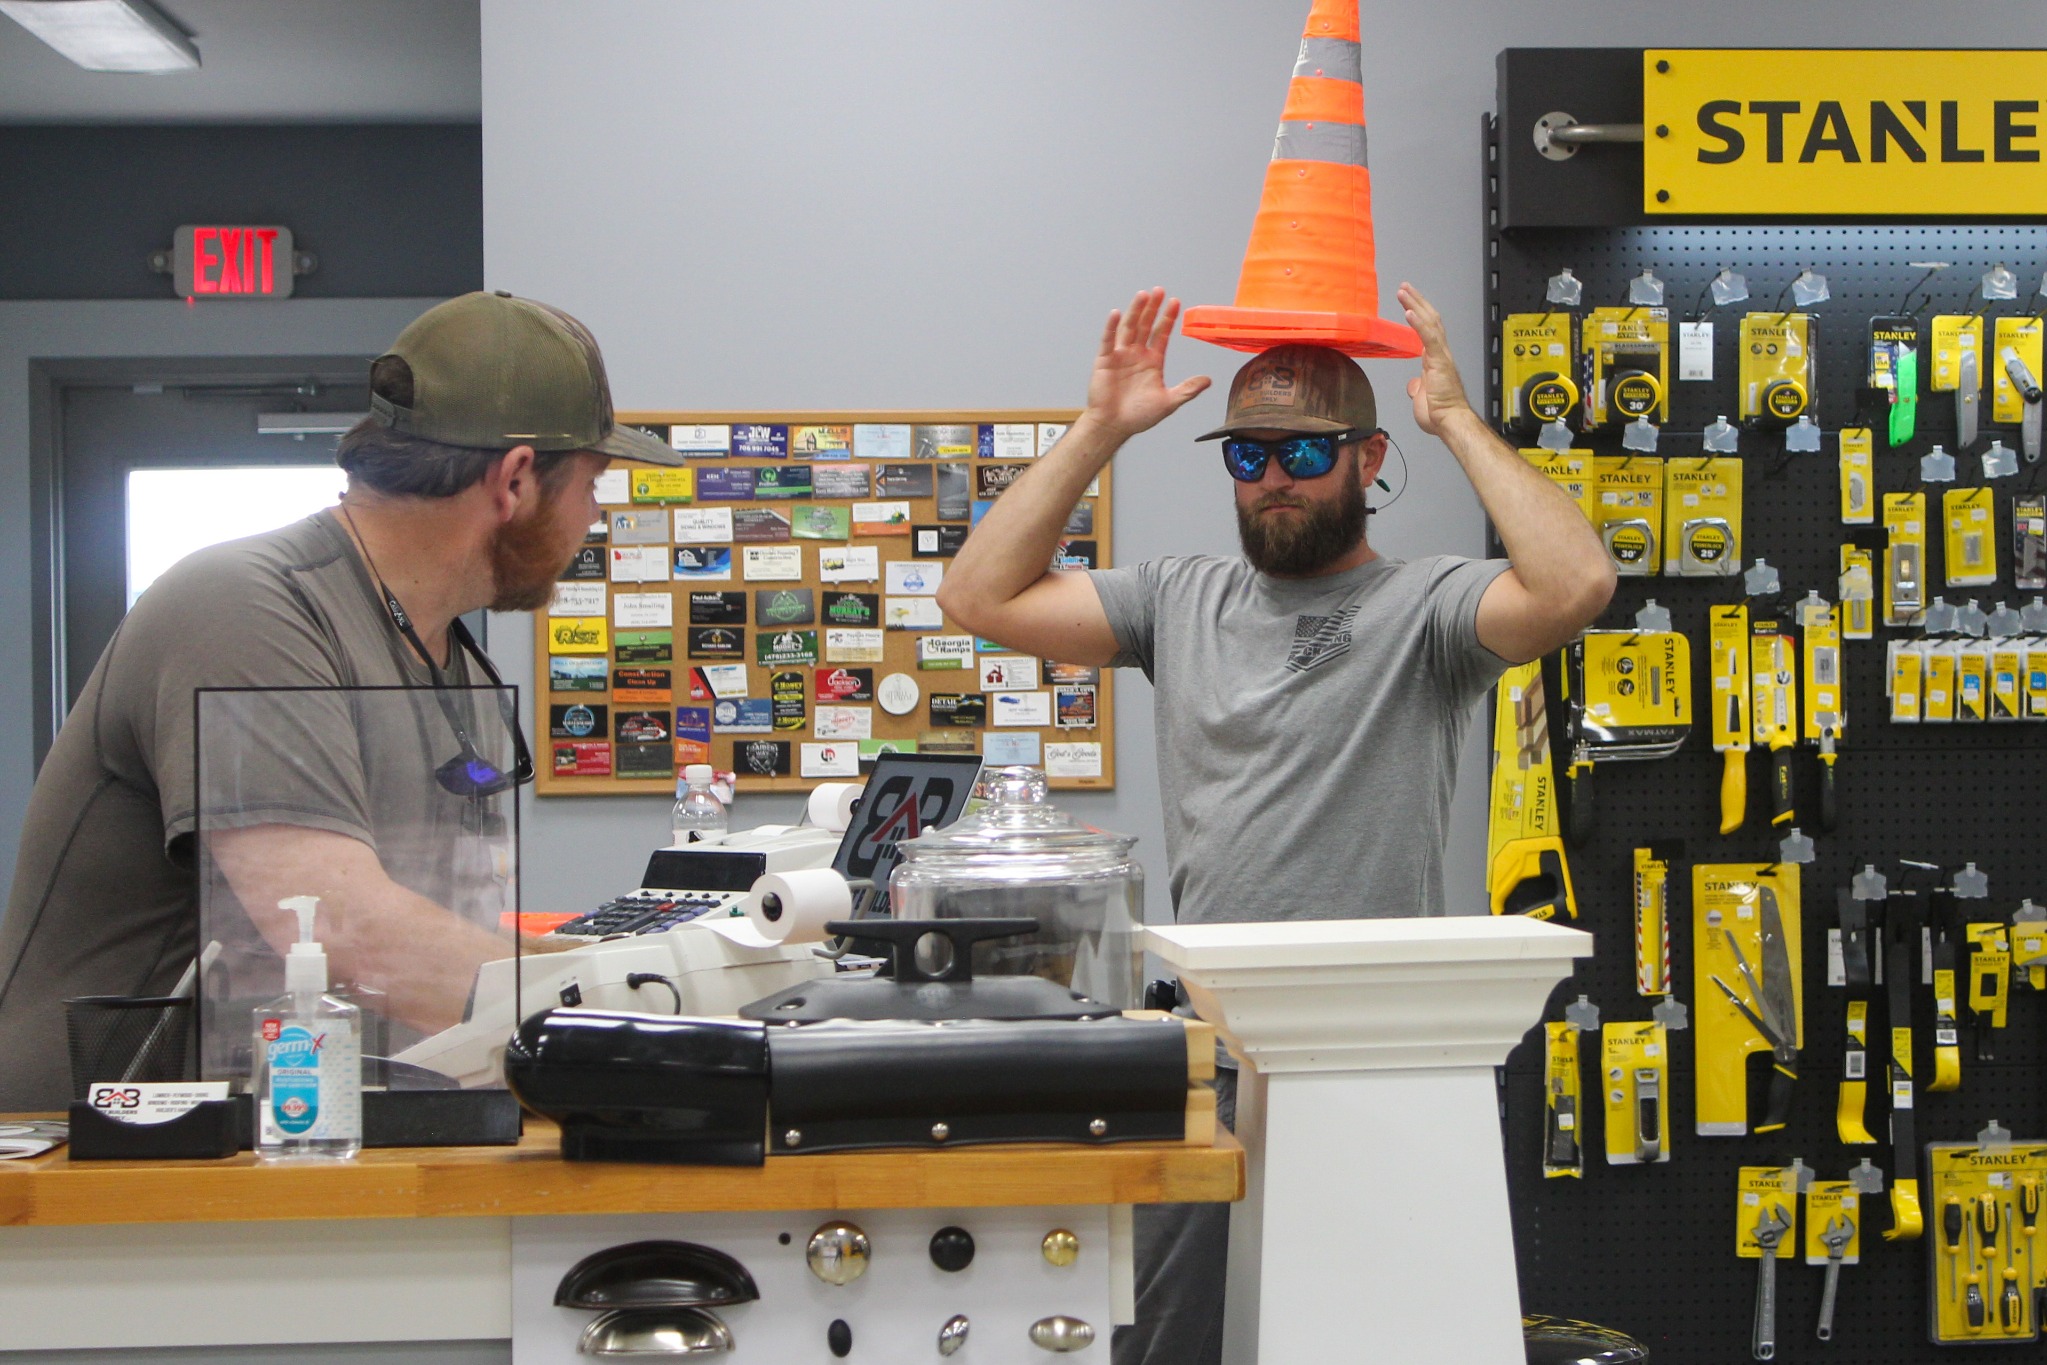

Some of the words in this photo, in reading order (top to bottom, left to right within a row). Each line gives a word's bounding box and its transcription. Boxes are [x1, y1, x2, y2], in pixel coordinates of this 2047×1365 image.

[1696, 99, 2046, 164] STANLE
[194, 227, 279, 294] EXIT
[1513, 329, 1557, 337] STANLEY
[1751, 328, 1794, 336] STANLEY
[1873, 331, 1916, 340] STANLEY
[1629, 401, 1645, 410] 30'
[1541, 466, 1580, 475] ANLEY
[1599, 474, 1651, 483] STANLEY
[1673, 473, 1717, 481] STANLEY
[1621, 549, 1636, 558] 30'
[1700, 549, 1716, 558] 25'
[935, 639, 970, 648] Georgia
[1664, 638, 1675, 694] STANLEY
[1628, 729, 1675, 737] FATMAX
[1535, 776, 1547, 831] STANLEY
[1970, 1155, 2027, 1165] STANLEY
[1749, 1180, 1787, 1188] STANLEY
